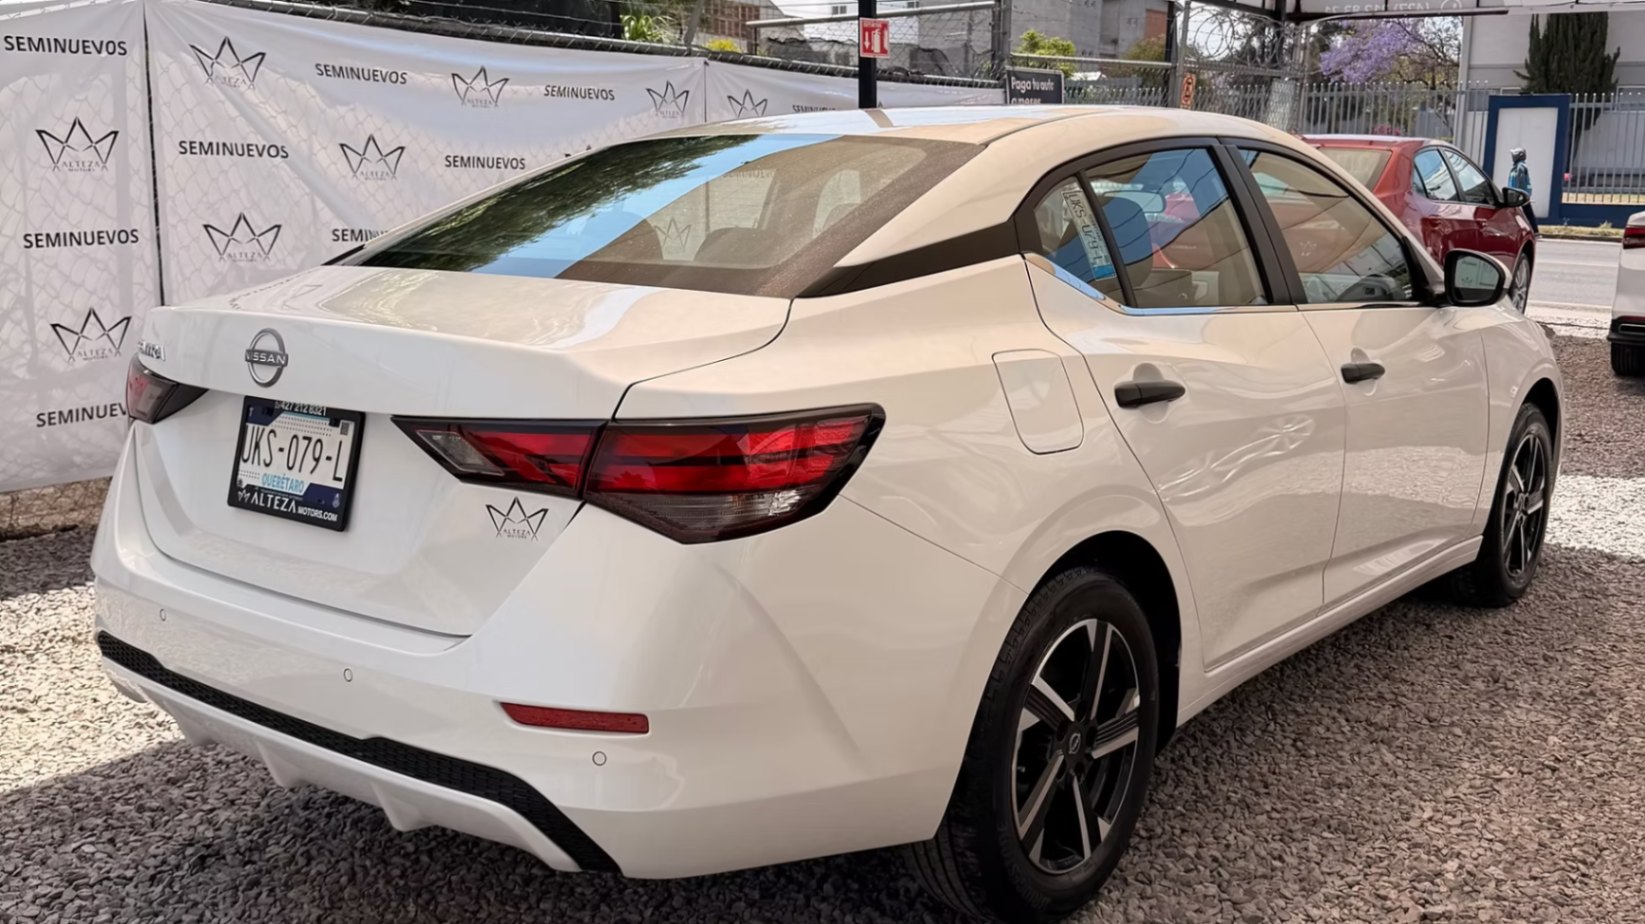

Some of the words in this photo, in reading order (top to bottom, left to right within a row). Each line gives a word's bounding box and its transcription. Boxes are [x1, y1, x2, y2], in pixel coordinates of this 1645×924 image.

[4, 35, 128, 55] SEMINUEVOS
[315, 63, 408, 85] SEMINUEVOS
[543, 84, 616, 102] SEMINUEVOS
[1010, 76, 1031, 94] Paga
[178, 140, 290, 160] SEMINUEVOS
[62, 160, 101, 169] ALTEZA
[445, 154, 527, 170] SEMINUEVOS
[23, 228, 139, 249] SEMINUEVOS
[77, 348, 114, 358] ALTEZA
[245, 351, 286, 365] NISSAN
[261, 473, 305, 494] QUERÉTARO
[250, 492, 297, 514] ALTEZA
[297, 506, 338, 522] MOTORS.COM
[502, 528, 531, 537] ALTEZA
